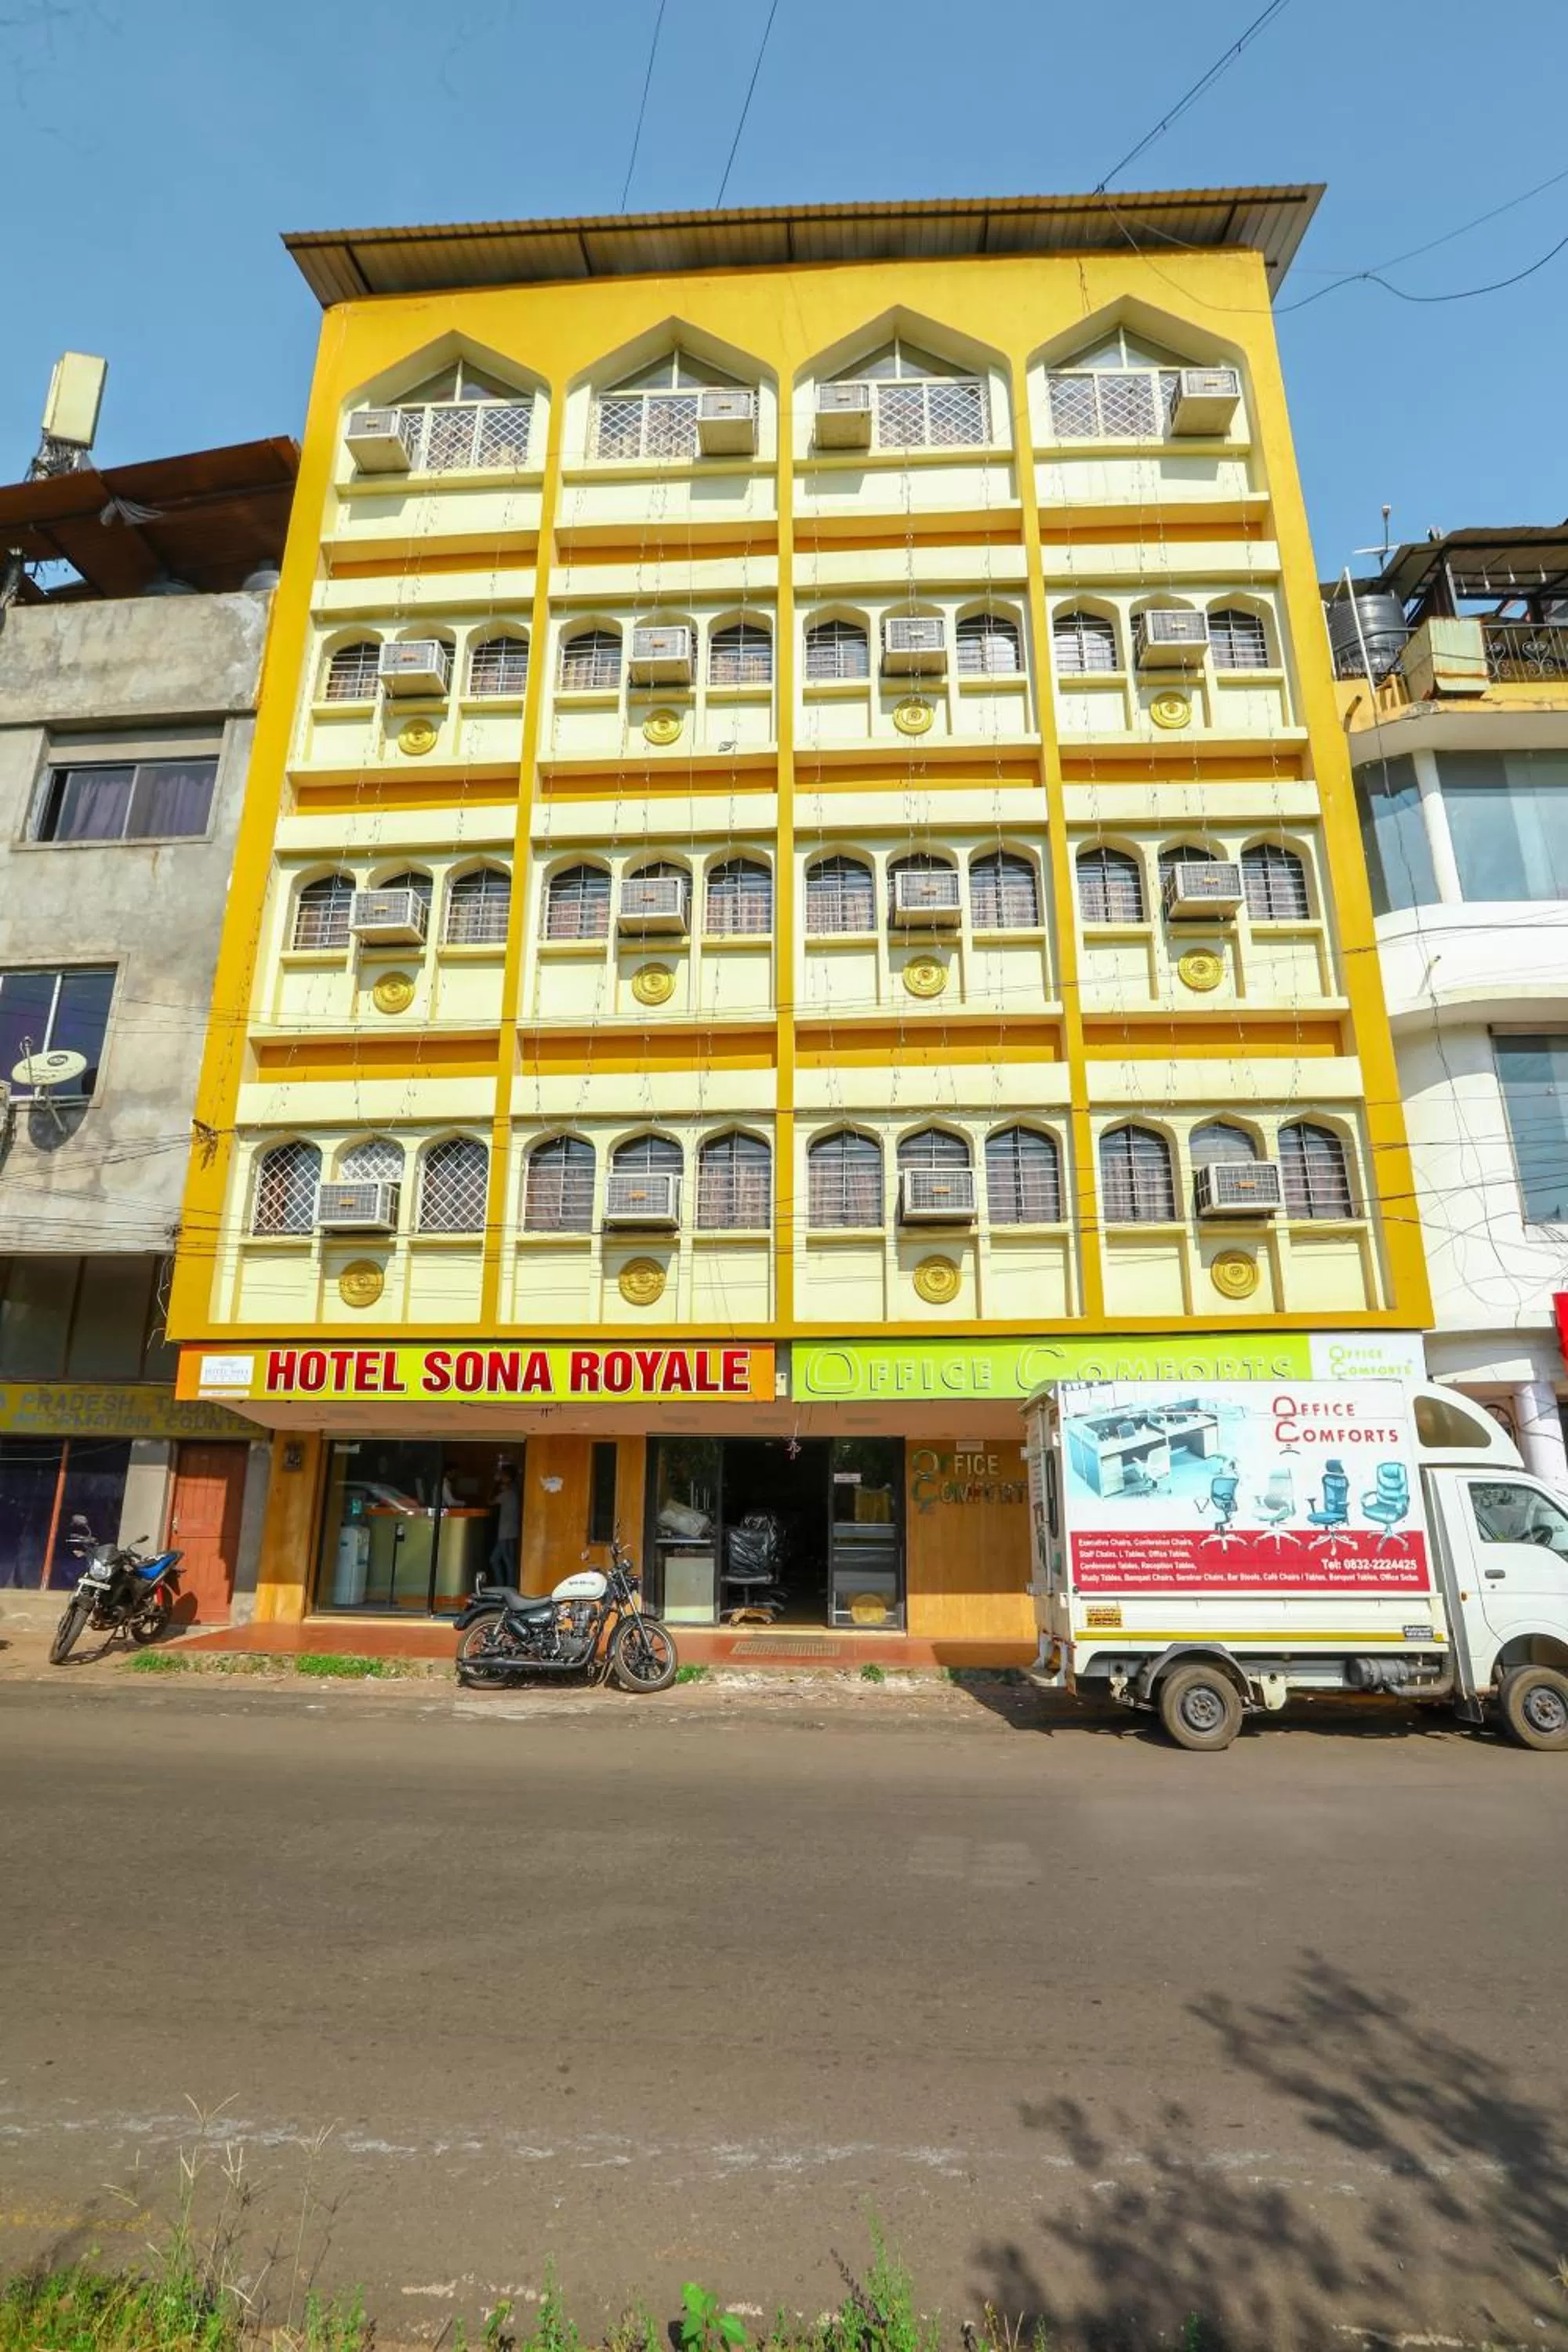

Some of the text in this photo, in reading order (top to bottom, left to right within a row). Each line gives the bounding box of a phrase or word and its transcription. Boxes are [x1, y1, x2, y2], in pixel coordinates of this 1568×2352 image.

[1329, 1345, 1383, 1362] OFFICE
[266, 1348, 752, 1395] HOTEL SONA ROYALE
[805, 1345, 993, 1395] OFFICE
[1272, 1396, 1356, 1417] OFFICE
[1276, 1421, 1399, 1443] COMFORTS
